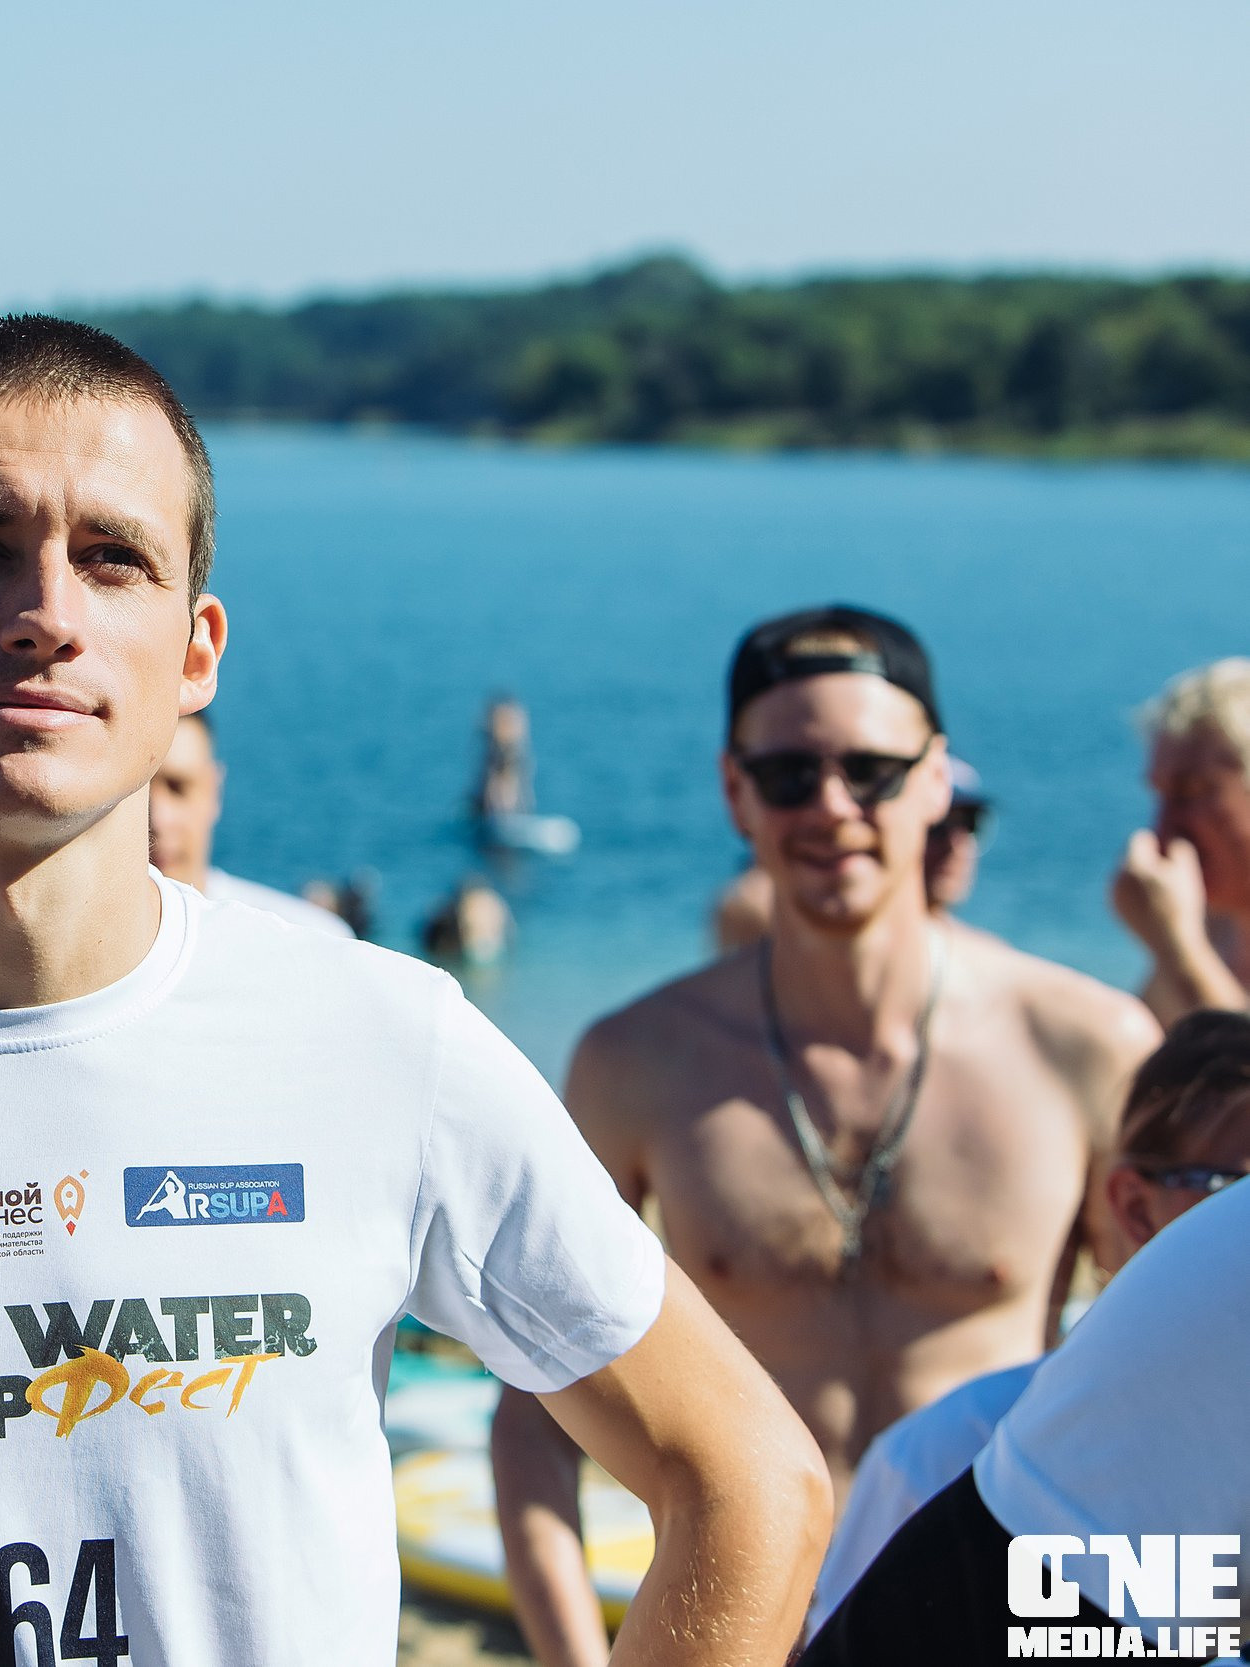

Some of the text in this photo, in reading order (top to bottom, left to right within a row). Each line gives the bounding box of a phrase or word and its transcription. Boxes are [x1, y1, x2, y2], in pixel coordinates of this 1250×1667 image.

[188, 1180, 280, 1190] RUSSIAN SUP ASSOCIATION
[188, 1190, 288, 1219] RSUPA
[2, 1230, 43, 1240] поддержки
[13, 1248, 44, 1257] области
[4, 1292, 318, 1369] WATER
